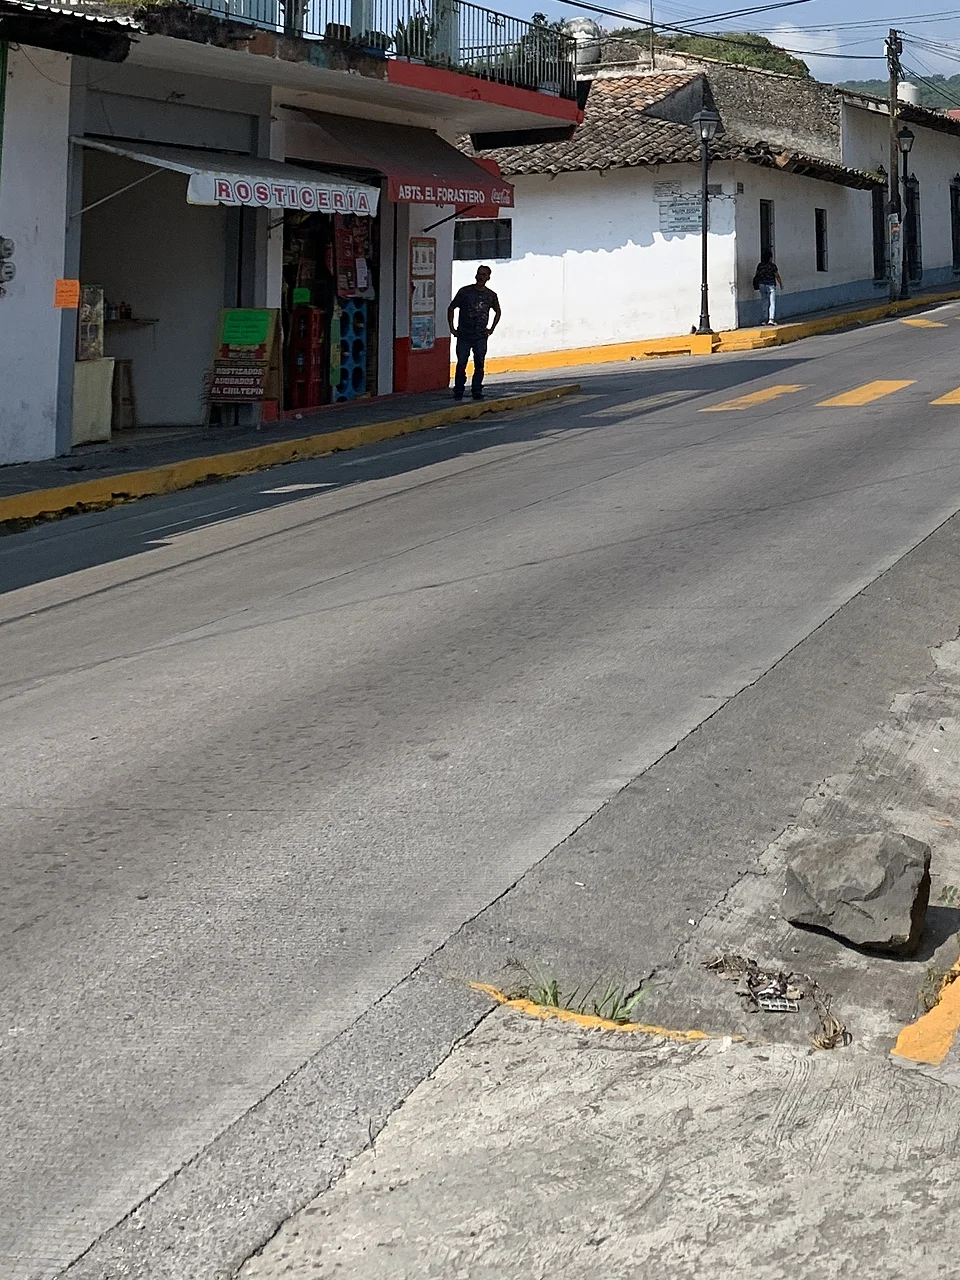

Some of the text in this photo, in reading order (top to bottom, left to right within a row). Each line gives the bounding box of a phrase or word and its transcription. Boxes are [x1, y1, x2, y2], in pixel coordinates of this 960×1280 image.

[215, 179, 370, 211] ROSTICERÍA
[398, 185, 486, 204] ABTS. EL FORASTERO
[214, 377, 254, 385] ADOBADOS
